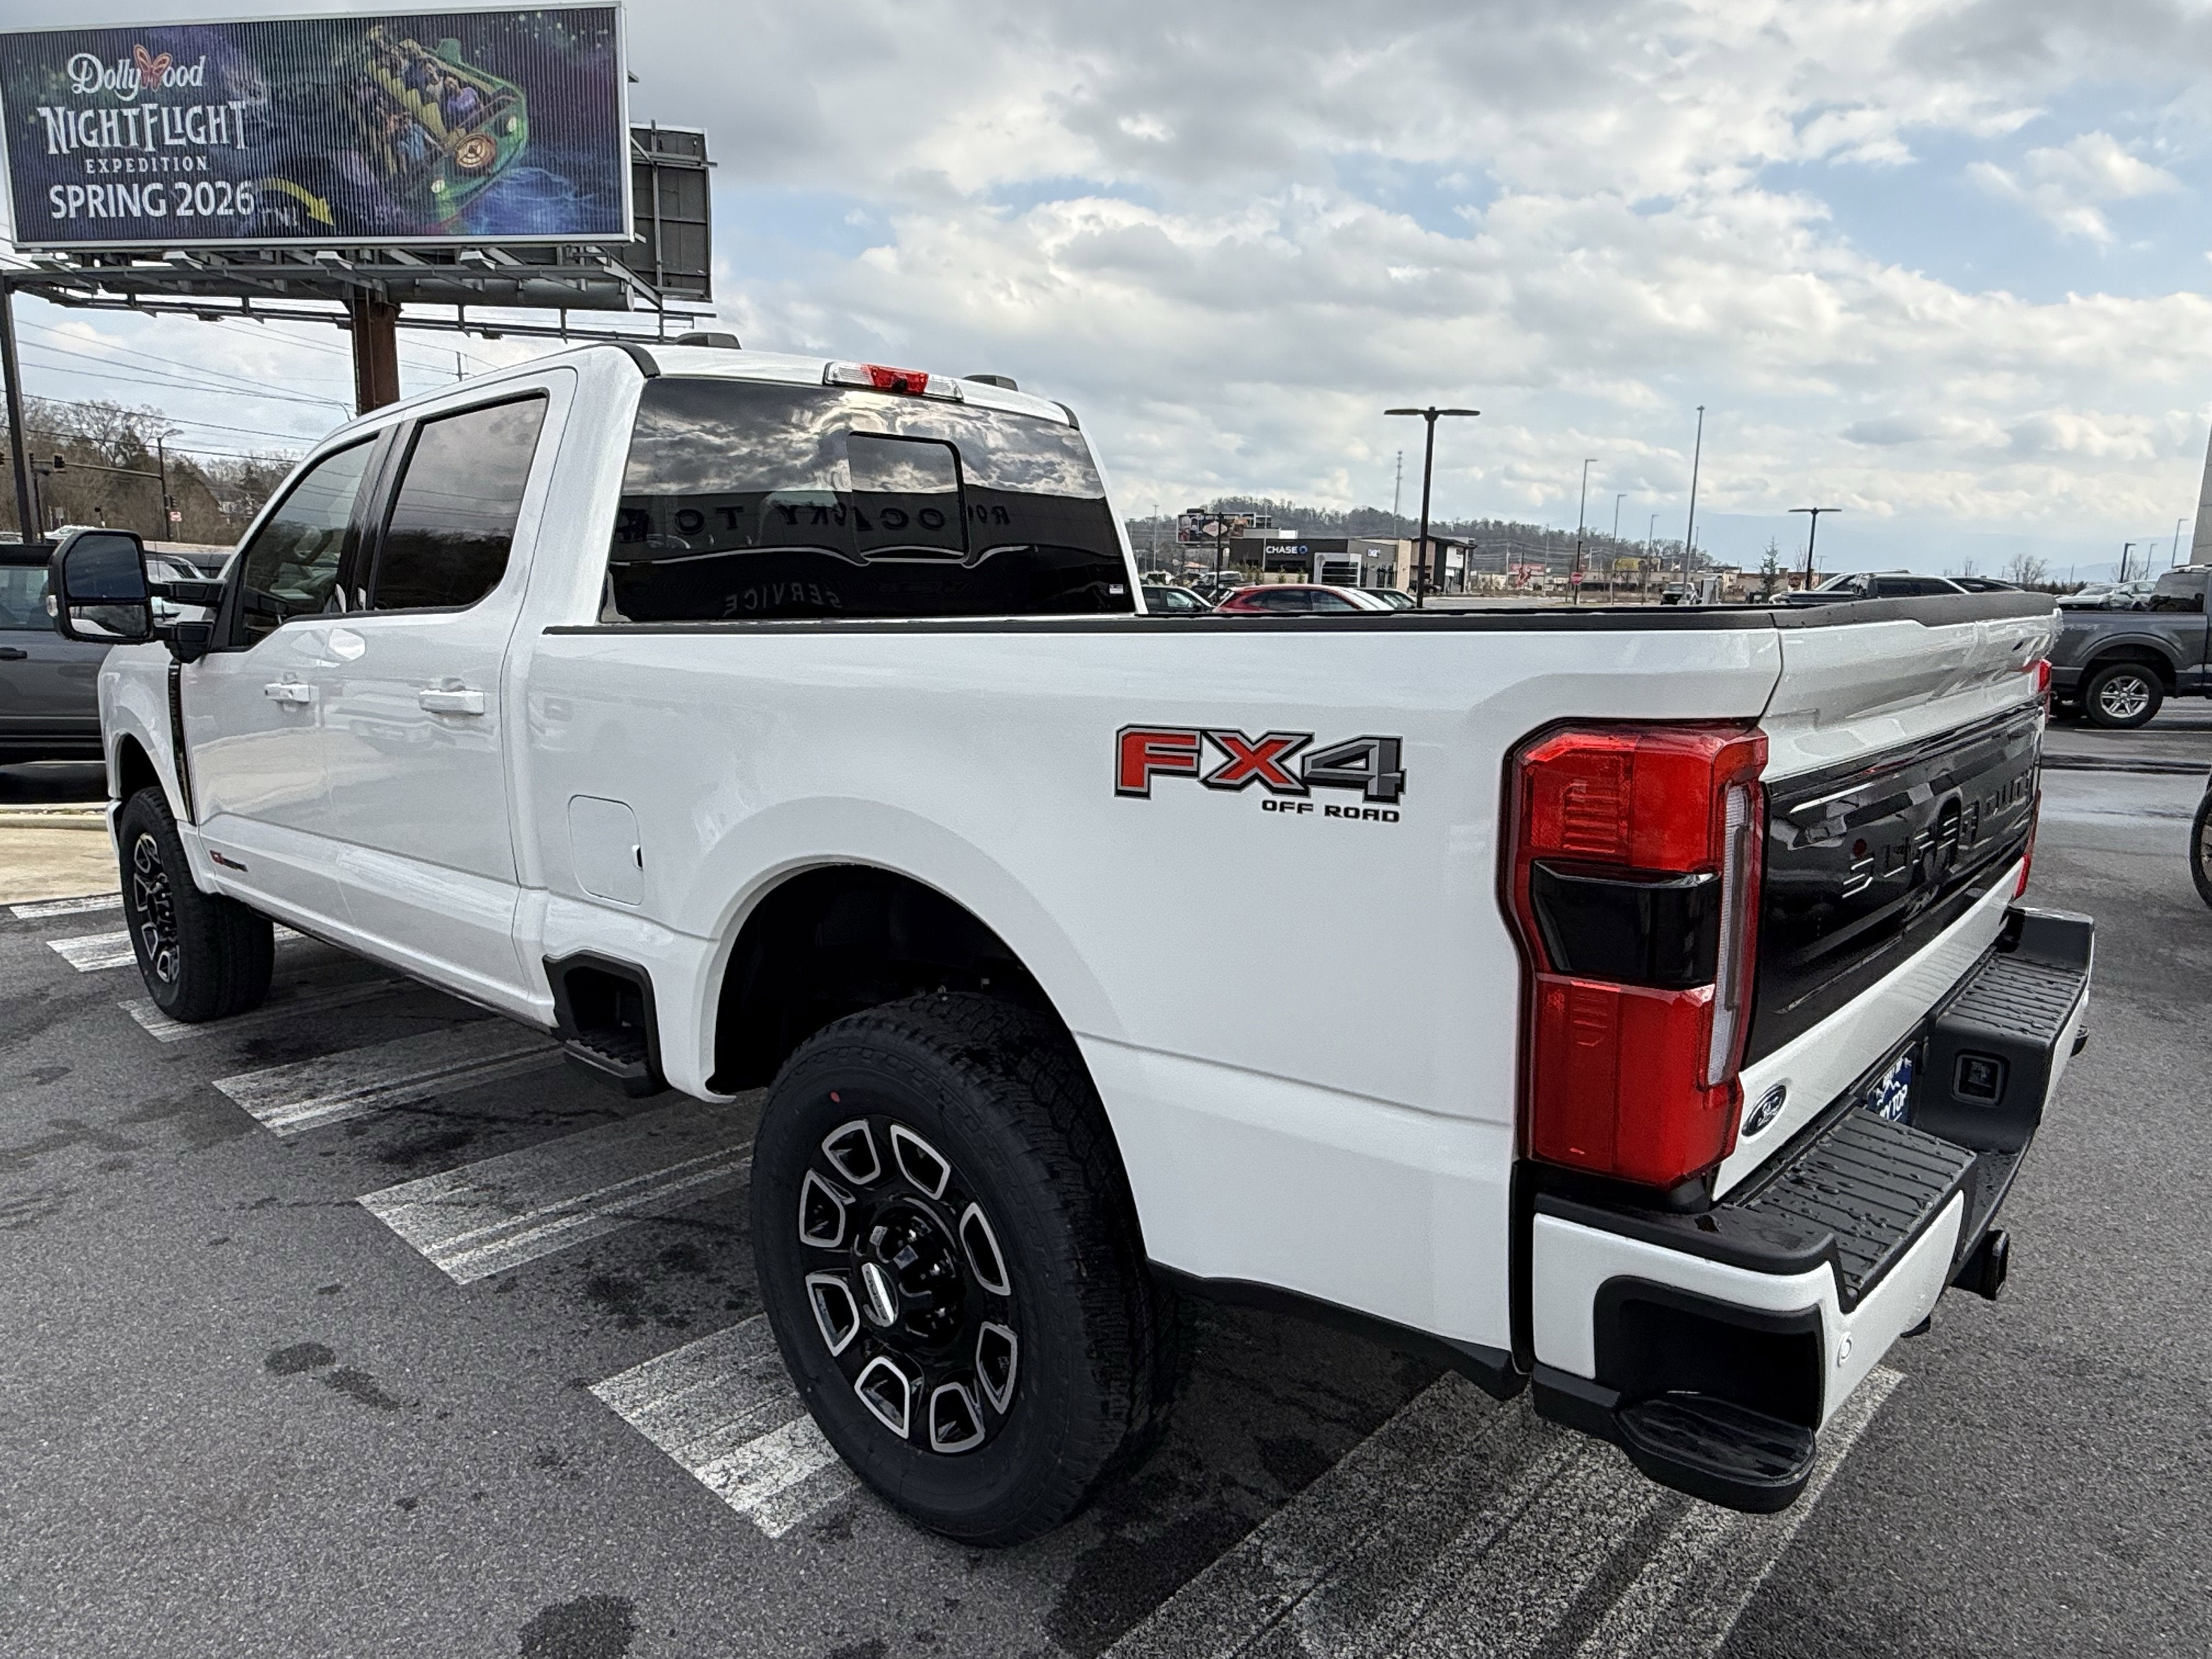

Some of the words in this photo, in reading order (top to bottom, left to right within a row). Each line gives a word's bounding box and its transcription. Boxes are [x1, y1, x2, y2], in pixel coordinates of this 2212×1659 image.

[86, 155, 208, 174] EXPEDITION
[49, 181, 166, 219] SPRING
[174, 180, 256, 217] 2026
[1266, 544, 1299, 555] CHASE
[1114, 723, 1407, 805] FX4
[1261, 799, 1314, 815] OFF
[1324, 804, 1401, 823] ROAD
